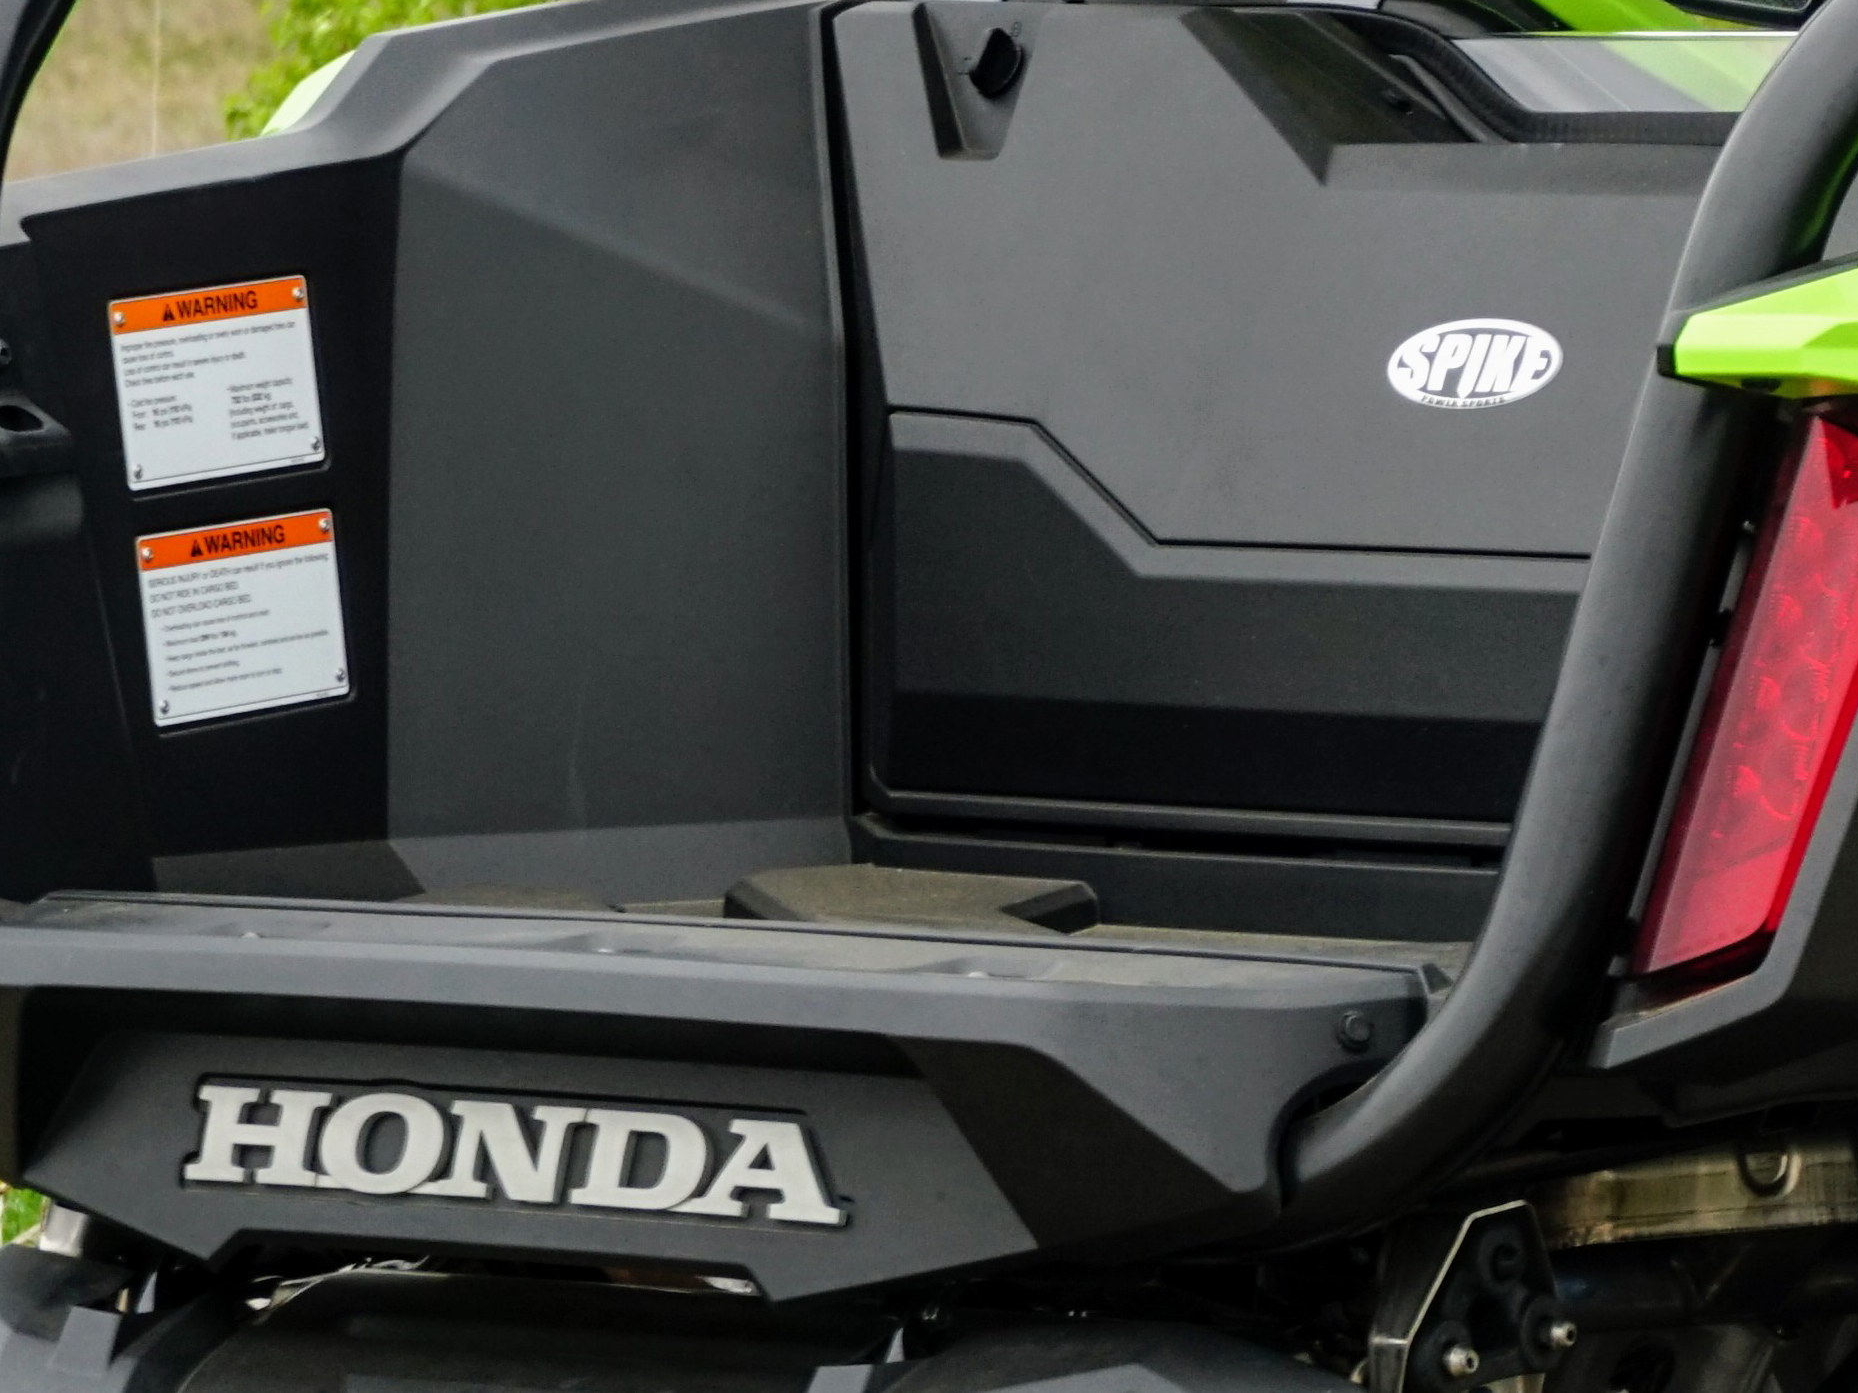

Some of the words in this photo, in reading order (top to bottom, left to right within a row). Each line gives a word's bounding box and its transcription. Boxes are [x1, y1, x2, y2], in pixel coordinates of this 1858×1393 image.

[176, 291, 257, 318] WARNING
[1396, 333, 1554, 399] SPIKE
[203, 525, 285, 553] WARNING
[183, 1084, 848, 1225] HONDA
